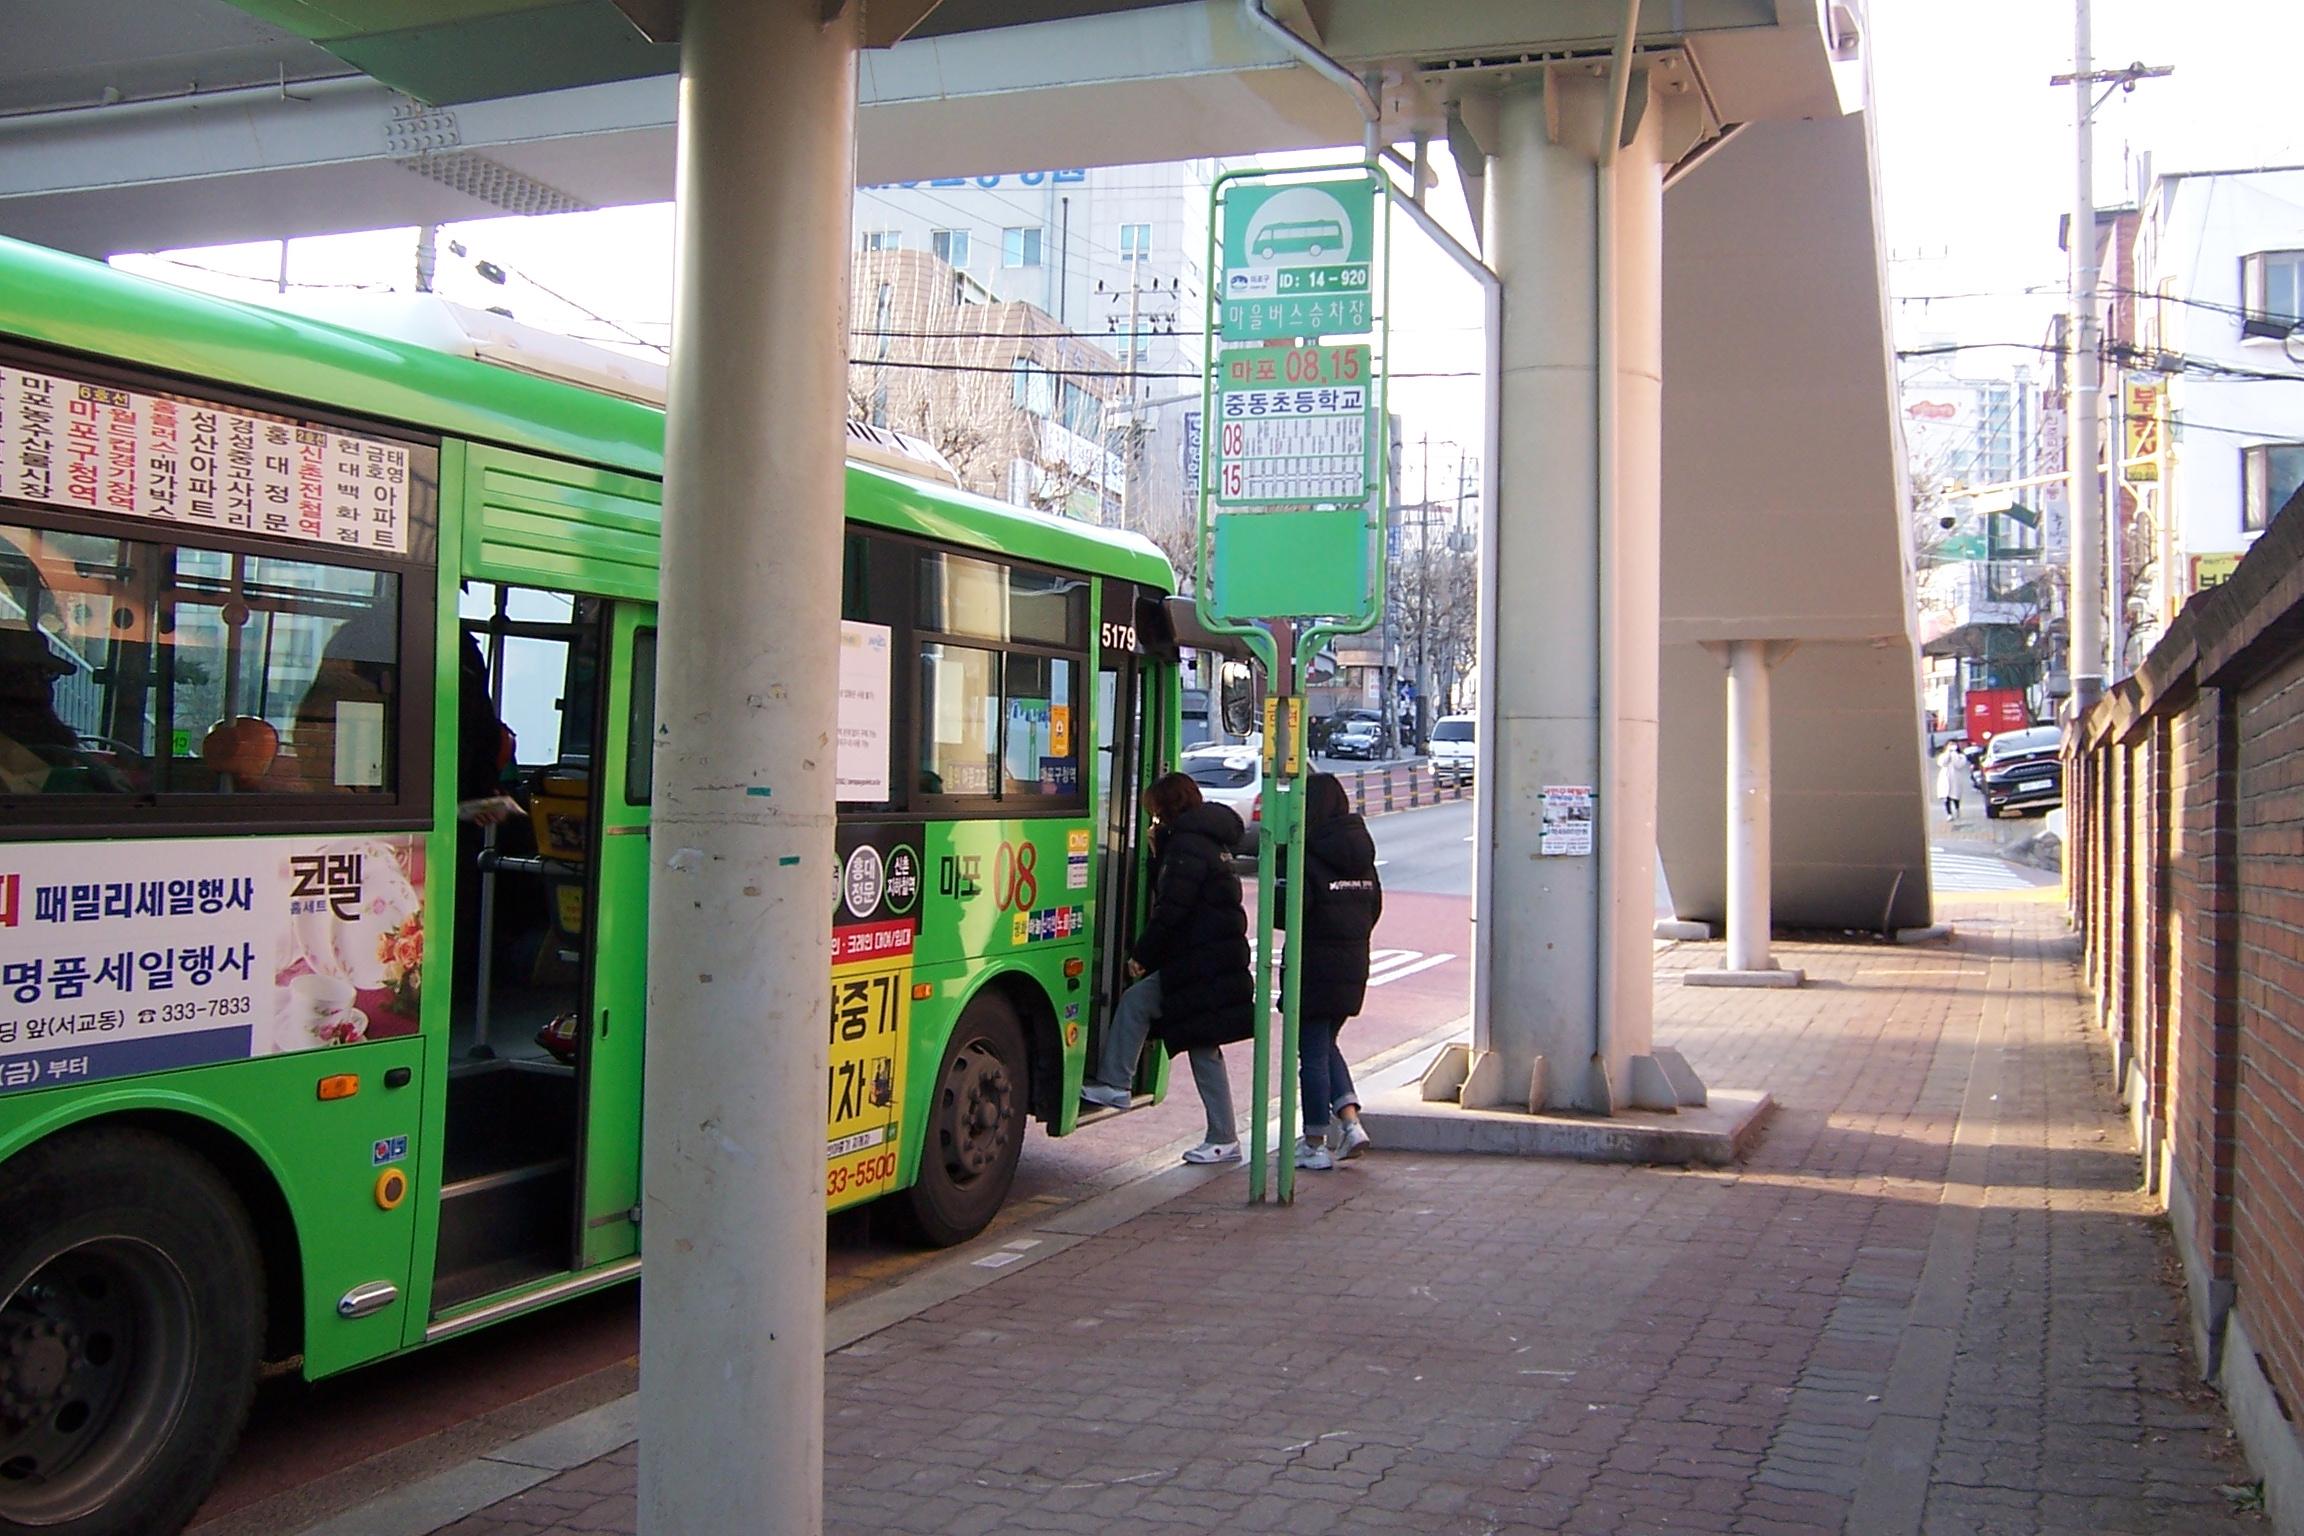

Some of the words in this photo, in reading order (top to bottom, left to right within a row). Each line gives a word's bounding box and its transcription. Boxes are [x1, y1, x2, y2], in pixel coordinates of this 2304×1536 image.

[1279, 273, 1299, 289] ID:
[1229, 299, 1365, 331] 마을버스승차장
[1231, 358, 1277, 384] 마포
[1285, 347, 1360, 385] 08.15
[80, 386, 128, 406] 6호선
[1225, 389, 1363, 417] 중동초등학교
[19, 376, 55, 499] 마포농수산물시장
[67, 400, 100, 506] 마포구청역
[107, 408, 138, 512] 월드컵경기장역
[1223, 423, 1242, 456] 08
[188, 412, 219, 520] 성산아파트
[227, 417, 255, 529] 경성중고사거리
[264, 425, 291, 533] 홍대정문
[1223, 464, 1241, 496] 15
[299, 446, 325, 538] 신촌전철역
[336, 439, 361, 544] 현대백화점
[1102, 622, 1136, 651] 5179
[290, 854, 362, 921] 코렐
[851, 856, 875, 881] 홍대
[940, 855, 982, 900] 마포
[994, 841, 1038, 912] 08
[35, 877, 254, 924] 패밀리세일행사
[851, 882, 875, 905] 정문
[847, 934, 873, 954] 크레인
[3, 942, 255, 1004] 명품세일행사
[26, 1009, 125, 1040] 앞(서교동)
[162, 996, 250, 1023] 333-7833
[48, 1056, 89, 1079] 부터
[827, 1058, 865, 1125] 차
